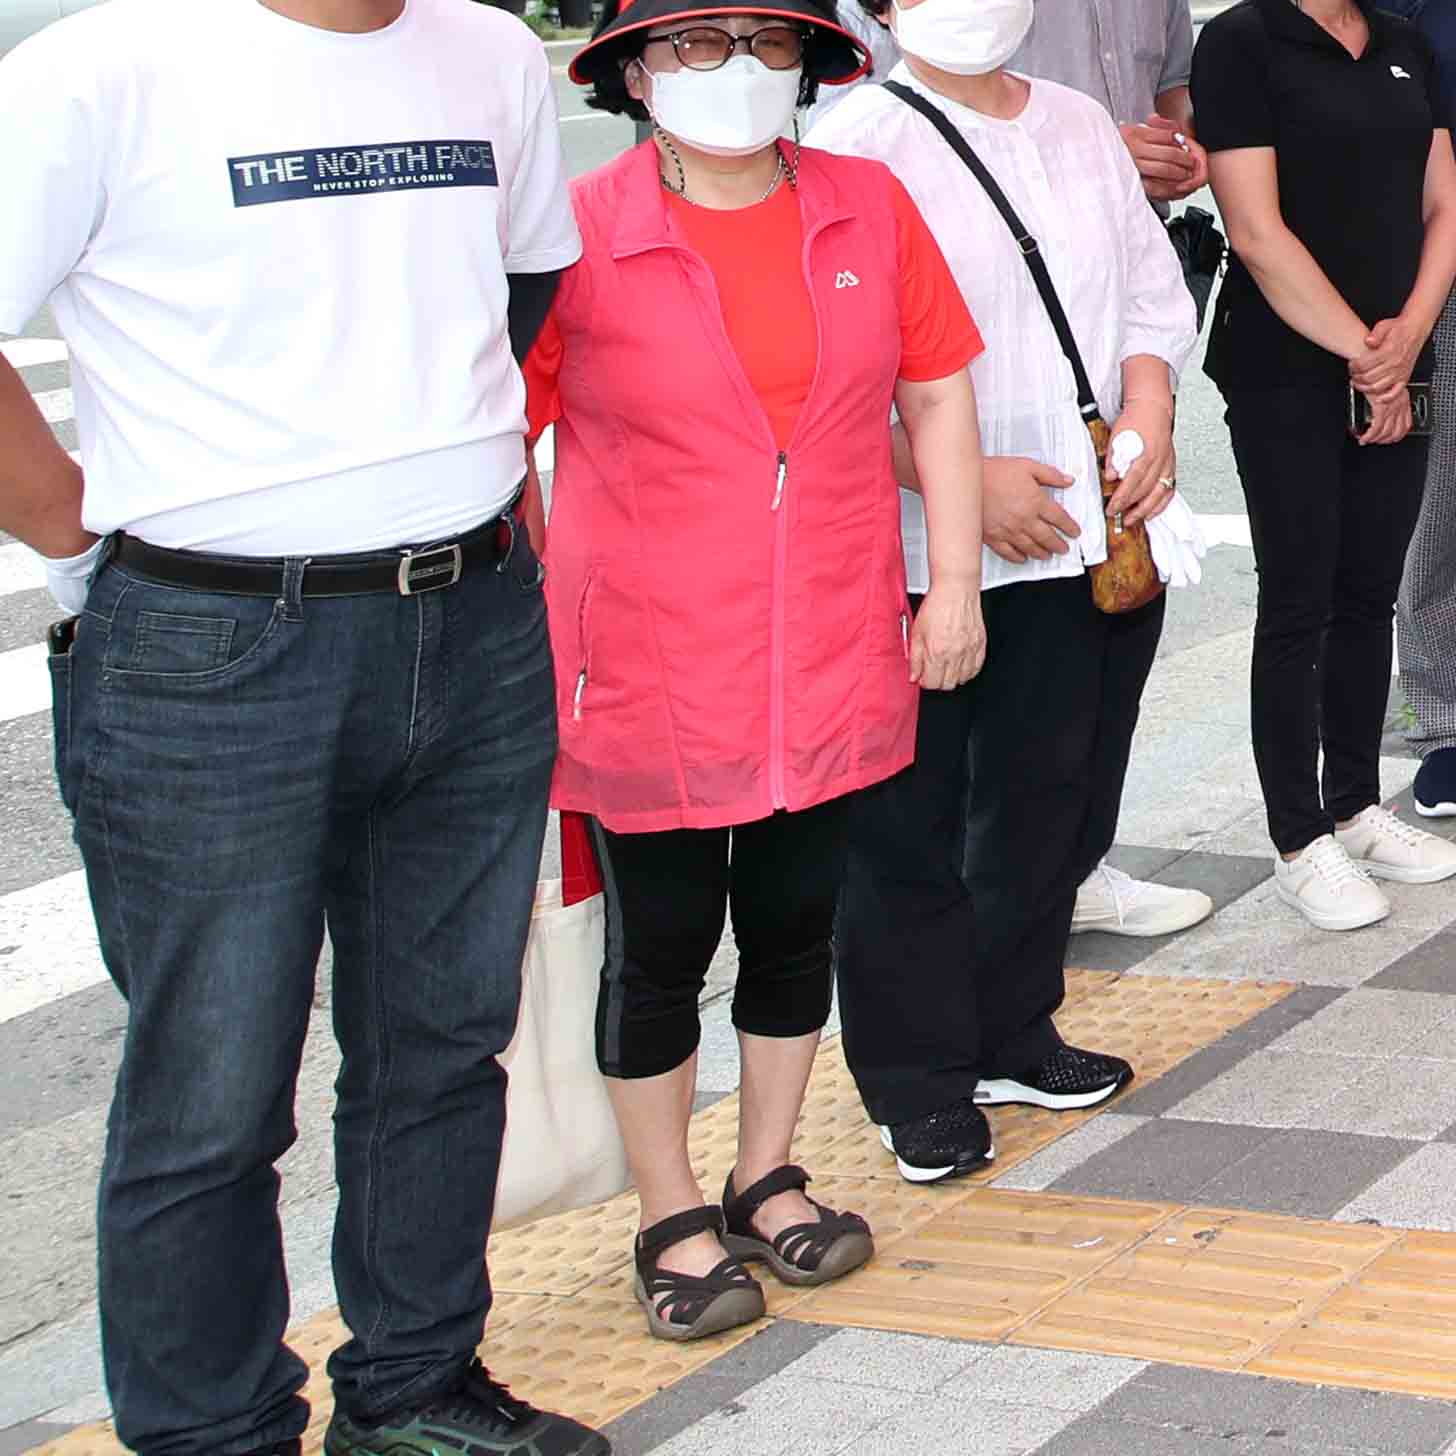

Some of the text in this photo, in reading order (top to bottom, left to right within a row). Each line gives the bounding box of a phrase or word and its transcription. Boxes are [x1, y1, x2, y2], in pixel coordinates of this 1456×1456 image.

[233, 144, 494, 187] THE NORTH FACE
[313, 173, 455, 192] NEVER STOP EXPLORING
